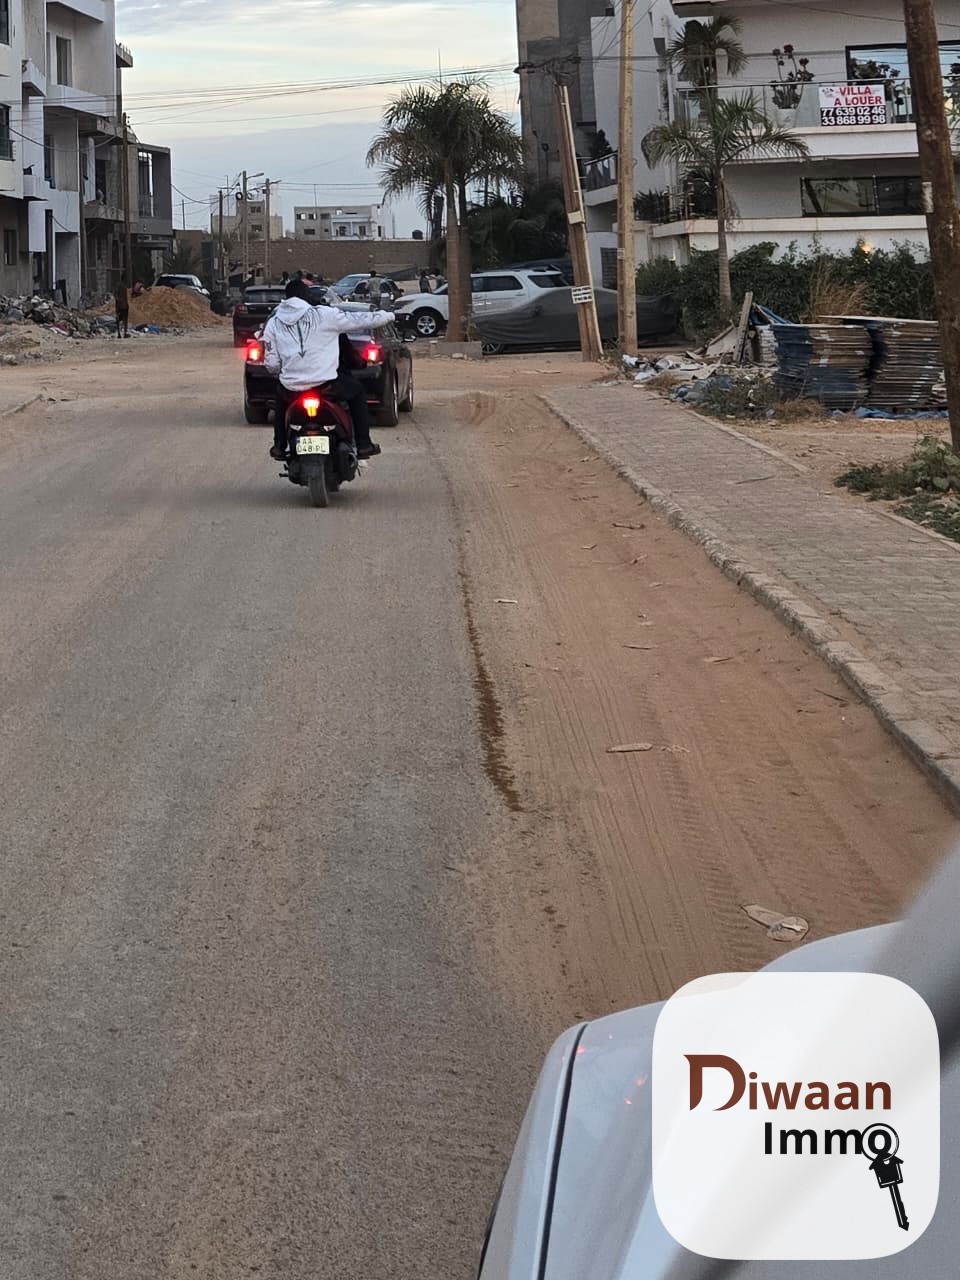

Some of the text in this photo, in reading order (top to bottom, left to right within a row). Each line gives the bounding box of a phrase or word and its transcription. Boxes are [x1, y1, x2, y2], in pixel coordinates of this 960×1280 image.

[839, 86, 872, 96] VILLA
[833, 96, 883, 106] A LOUER
[821, 105, 885, 117] 77 639 02 46
[822, 114, 886, 126] 33 868 99 98
